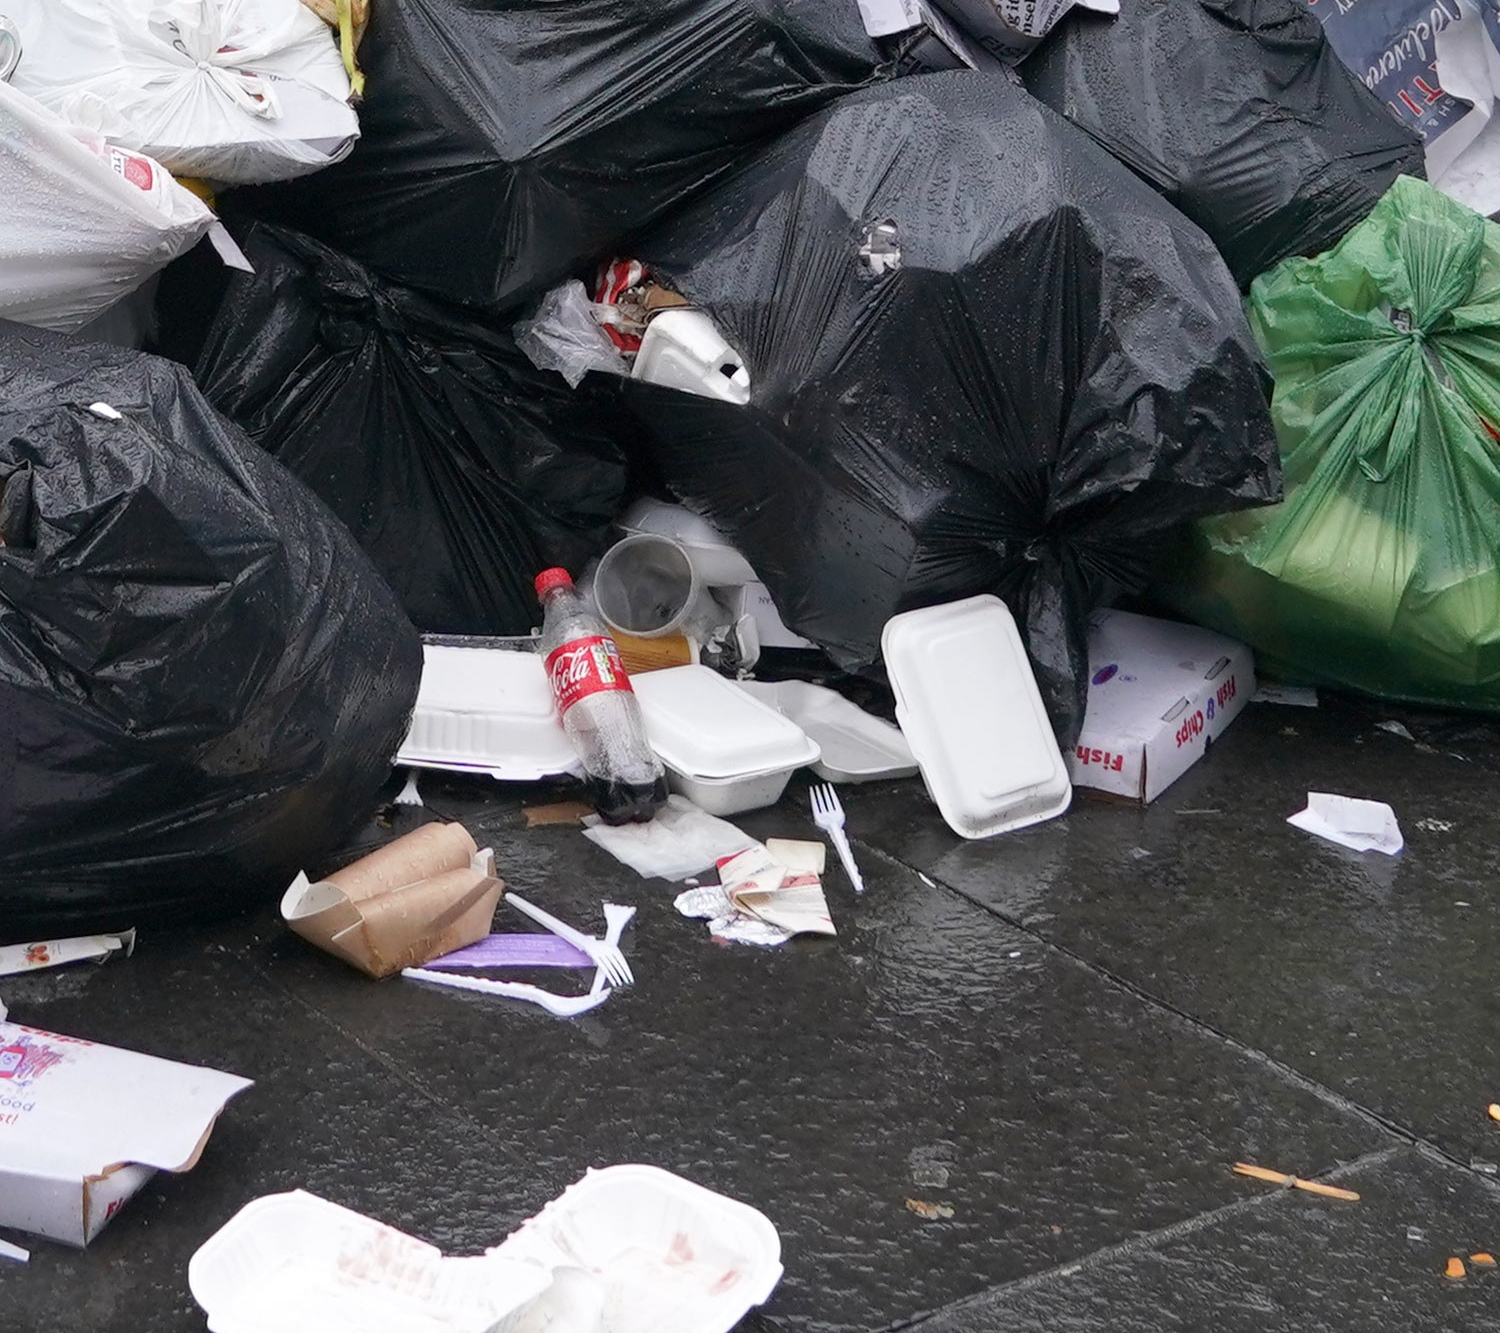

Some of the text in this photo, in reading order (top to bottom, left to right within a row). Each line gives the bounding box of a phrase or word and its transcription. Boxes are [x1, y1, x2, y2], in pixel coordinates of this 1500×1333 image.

[554, 646, 592, 696] Cola
[1175, 674, 1238, 749] Fish & Chips
[1076, 744, 1124, 773] Fish
